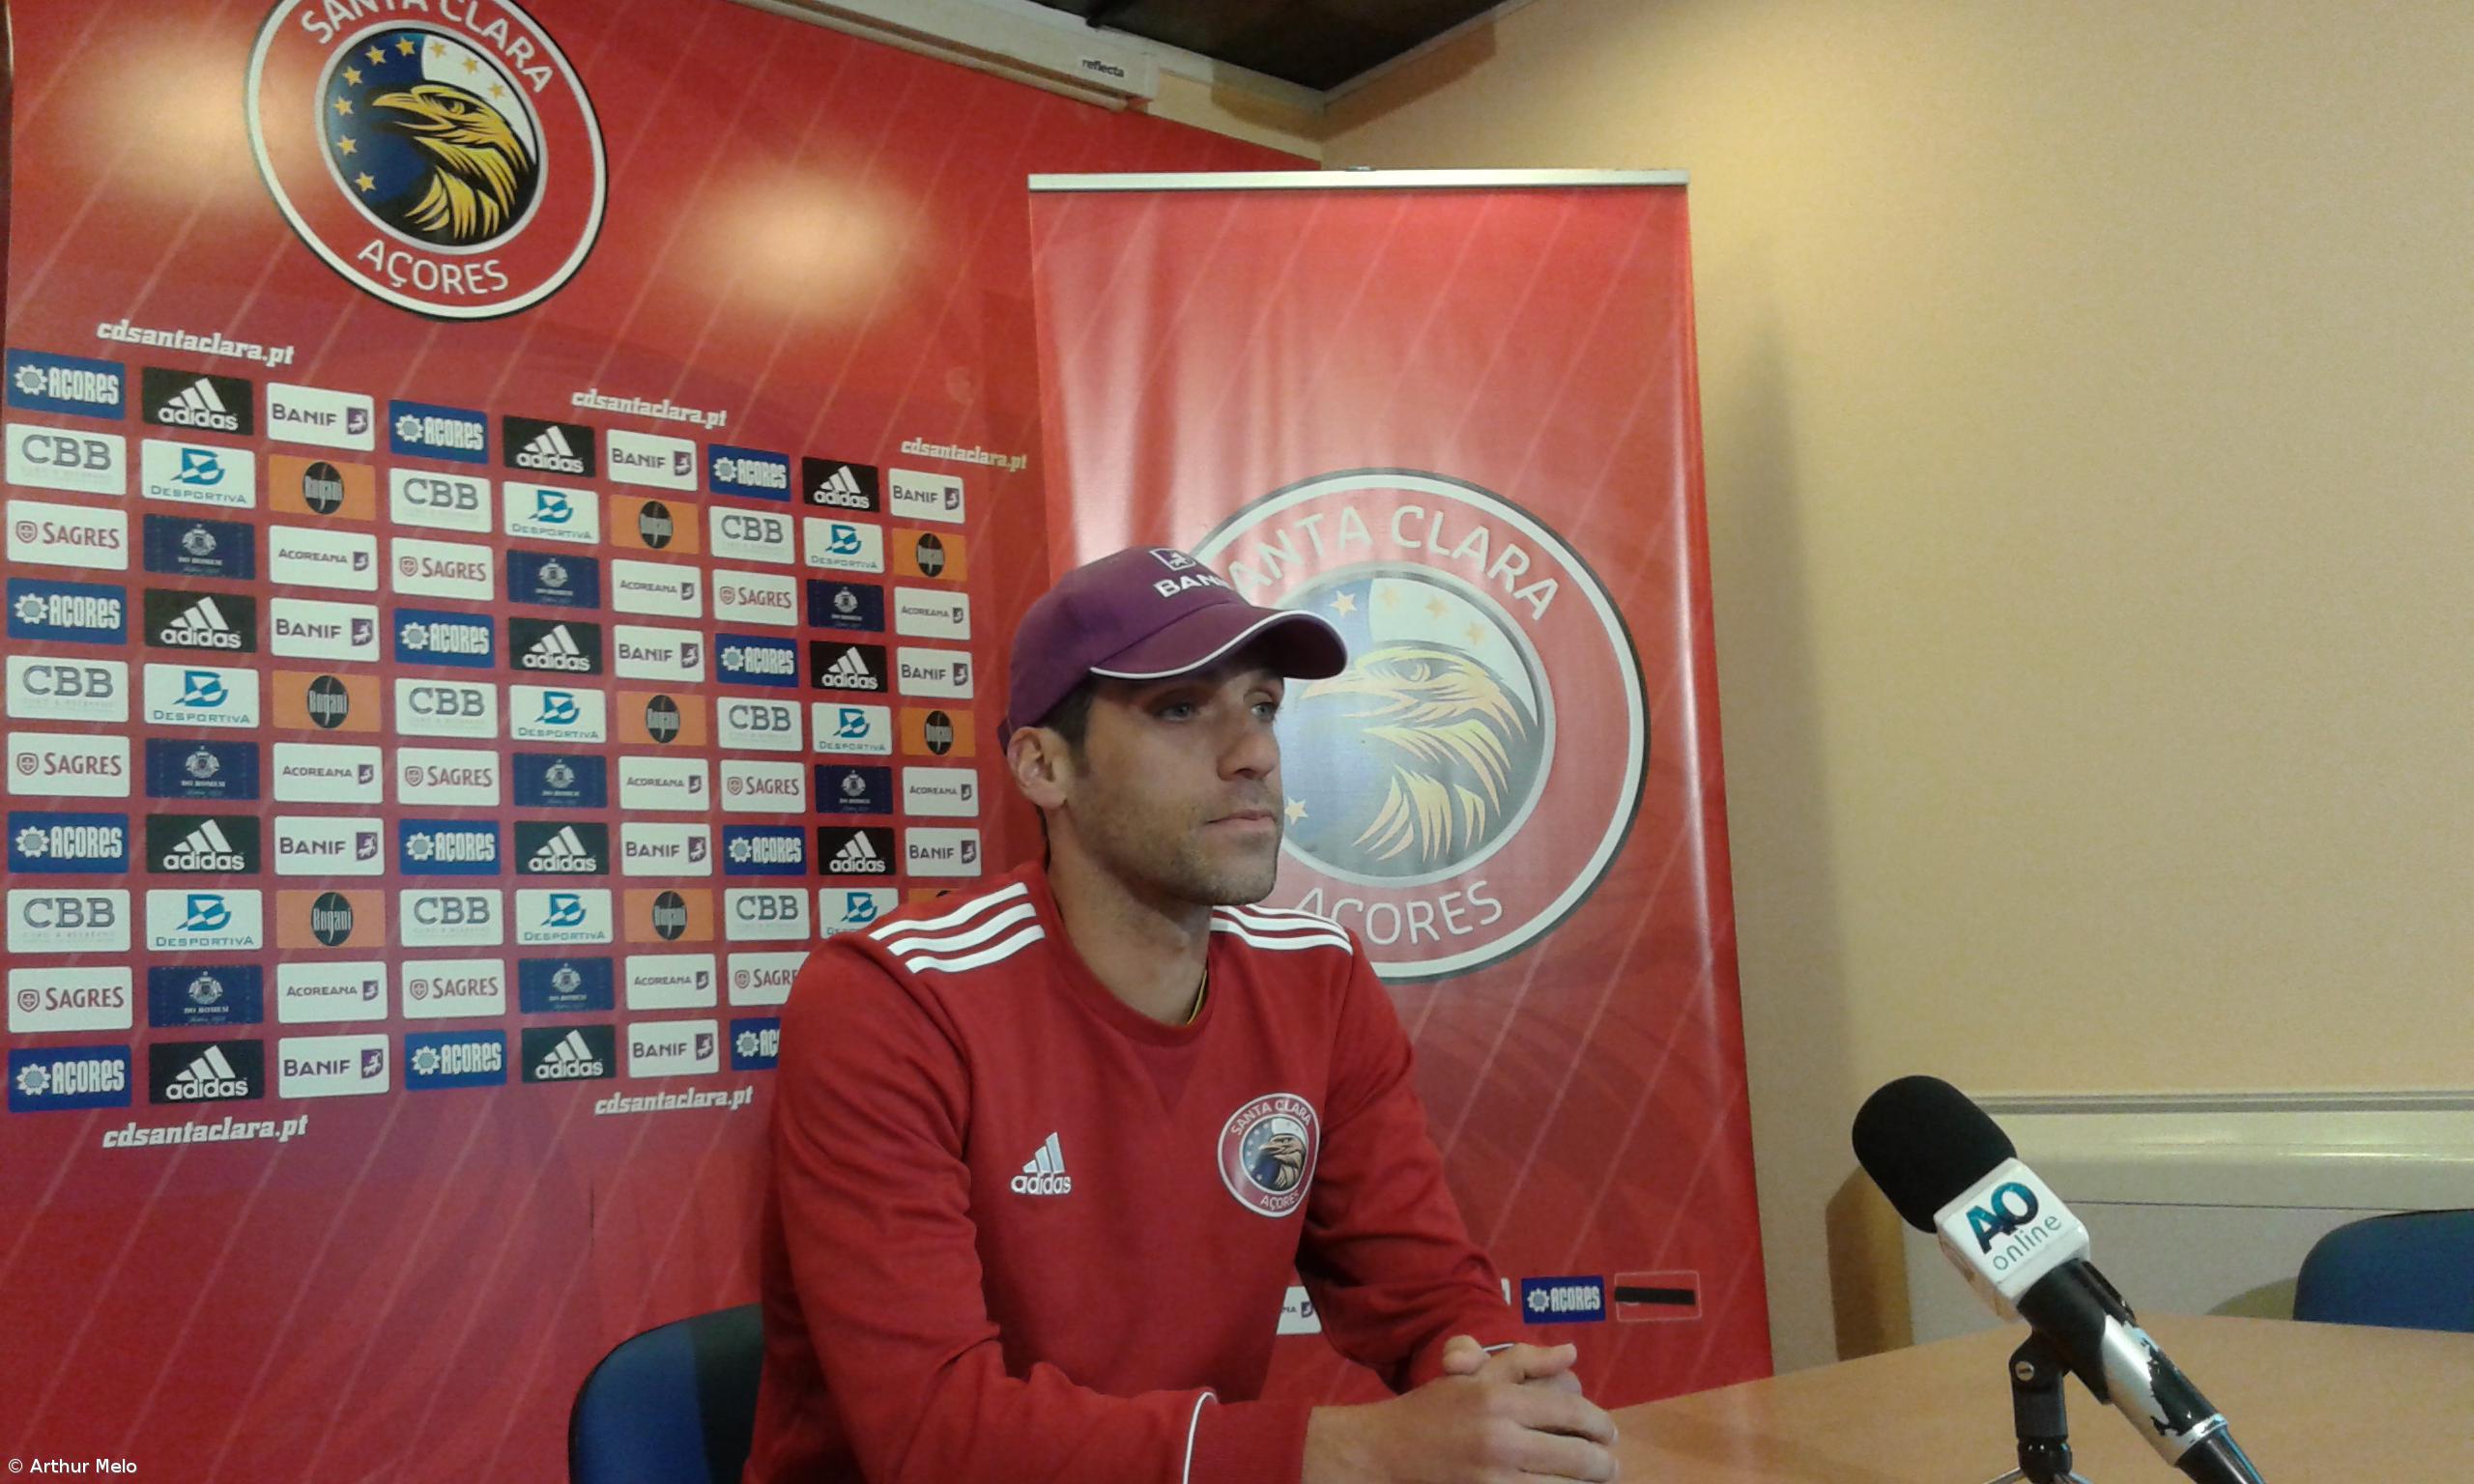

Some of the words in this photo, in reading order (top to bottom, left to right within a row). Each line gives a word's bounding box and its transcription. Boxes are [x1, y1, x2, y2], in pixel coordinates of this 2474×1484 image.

[1081, 58, 1125, 78] reflecta
[358, 239, 508, 296] AÇORES
[97, 319, 295, 367] cdsantaclara.pt
[158, 407, 239, 431] adidas
[272, 403, 338, 427] BANIF
[572, 388, 728, 430] cdsantaclara.pt
[22, 434, 112, 471] CBB
[516, 451, 584, 473] adidas
[612, 448, 666, 469] BANIF
[403, 478, 479, 510] CBB
[814, 490, 870, 509] adidas
[893, 485, 938, 503] BANIF
[43, 522, 121, 550] SAGRES
[722, 515, 784, 544] CBB
[422, 557, 487, 582] SAGRES
[1227, 505, 1374, 595] ANTA
[1391, 504, 1561, 621] CLARA
[738, 586, 791, 609] SAGRES
[160, 629, 242, 649] adidas
[275, 618, 342, 640] BANIF
[522, 653, 590, 671] adidas
[618, 643, 674, 662] BANIF
[23, 666, 115, 699] CBB
[821, 675, 878, 689] adidas
[902, 665, 947, 680] BANIF
[409, 687, 485, 717] CBB
[729, 705, 791, 731] CBB
[43, 753, 122, 776] SAGRES
[428, 766, 493, 787] SAGRES
[746, 776, 800, 796] SAGRES
[280, 837, 347, 855] BANIF
[626, 842, 680, 858] BANIF
[909, 844, 955, 860] BANIF
[163, 852, 245, 870] adidas
[528, 855, 596, 872] adidas
[829, 859, 886, 872] adidas
[23, 898, 116, 928] CBB
[414, 897, 491, 925] CBB
[736, 896, 798, 921] CBB
[432, 977, 500, 1000] SAGRES
[754, 969, 797, 987] SAGR
[45, 986, 126, 1011] SAGRES
[633, 1042, 687, 1059] BANIF
[284, 1059, 352, 1077] BANIF
[534, 1060, 604, 1079] adidas
[166, 1080, 249, 1100] adidas
[594, 1085, 754, 1115] cdsantaclara.pt
[1230, 1102, 1273, 1135] SANTA
[1275, 1099, 1312, 1127] CLARA
[102, 1115, 309, 1149] cdsantaclara.pt
[1011, 1172, 1072, 1195] adidas
[1993, 1214, 2062, 1271] online
